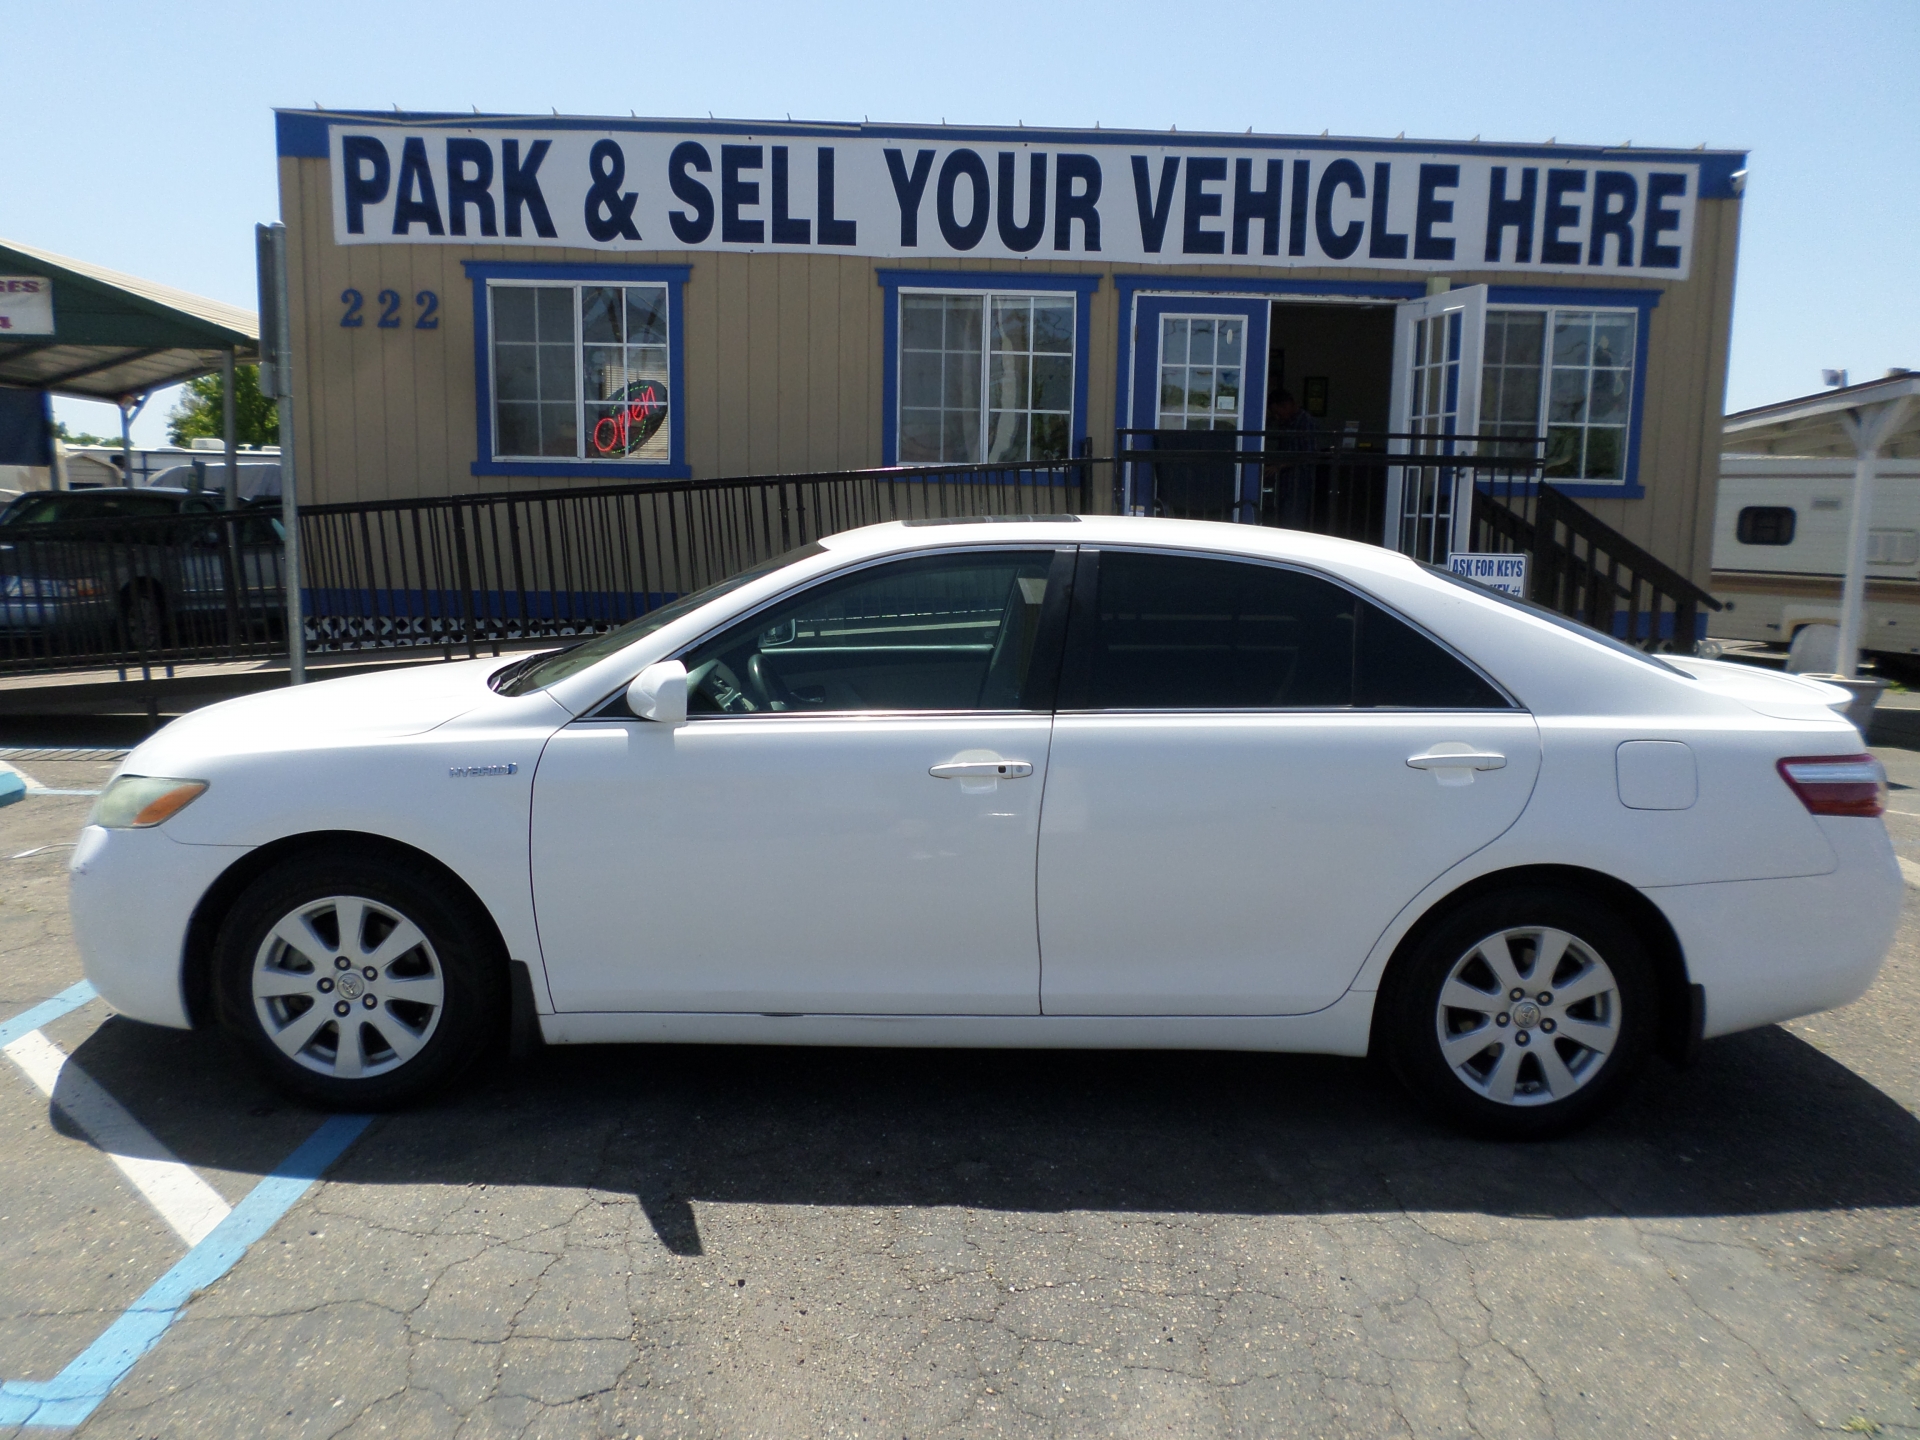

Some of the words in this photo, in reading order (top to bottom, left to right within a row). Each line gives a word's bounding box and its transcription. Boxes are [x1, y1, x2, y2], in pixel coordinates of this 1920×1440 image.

[343, 136, 558, 239] PARK
[585, 139, 642, 242] &
[669, 141, 857, 247] SELL
[883, 148, 1102, 252] YOUR
[1131, 156, 1460, 261] VEHICLE
[1485, 166, 1687, 269] HERE
[1475, 559, 1494, 577] FOR
[1497, 560, 1523, 577] KEYS
